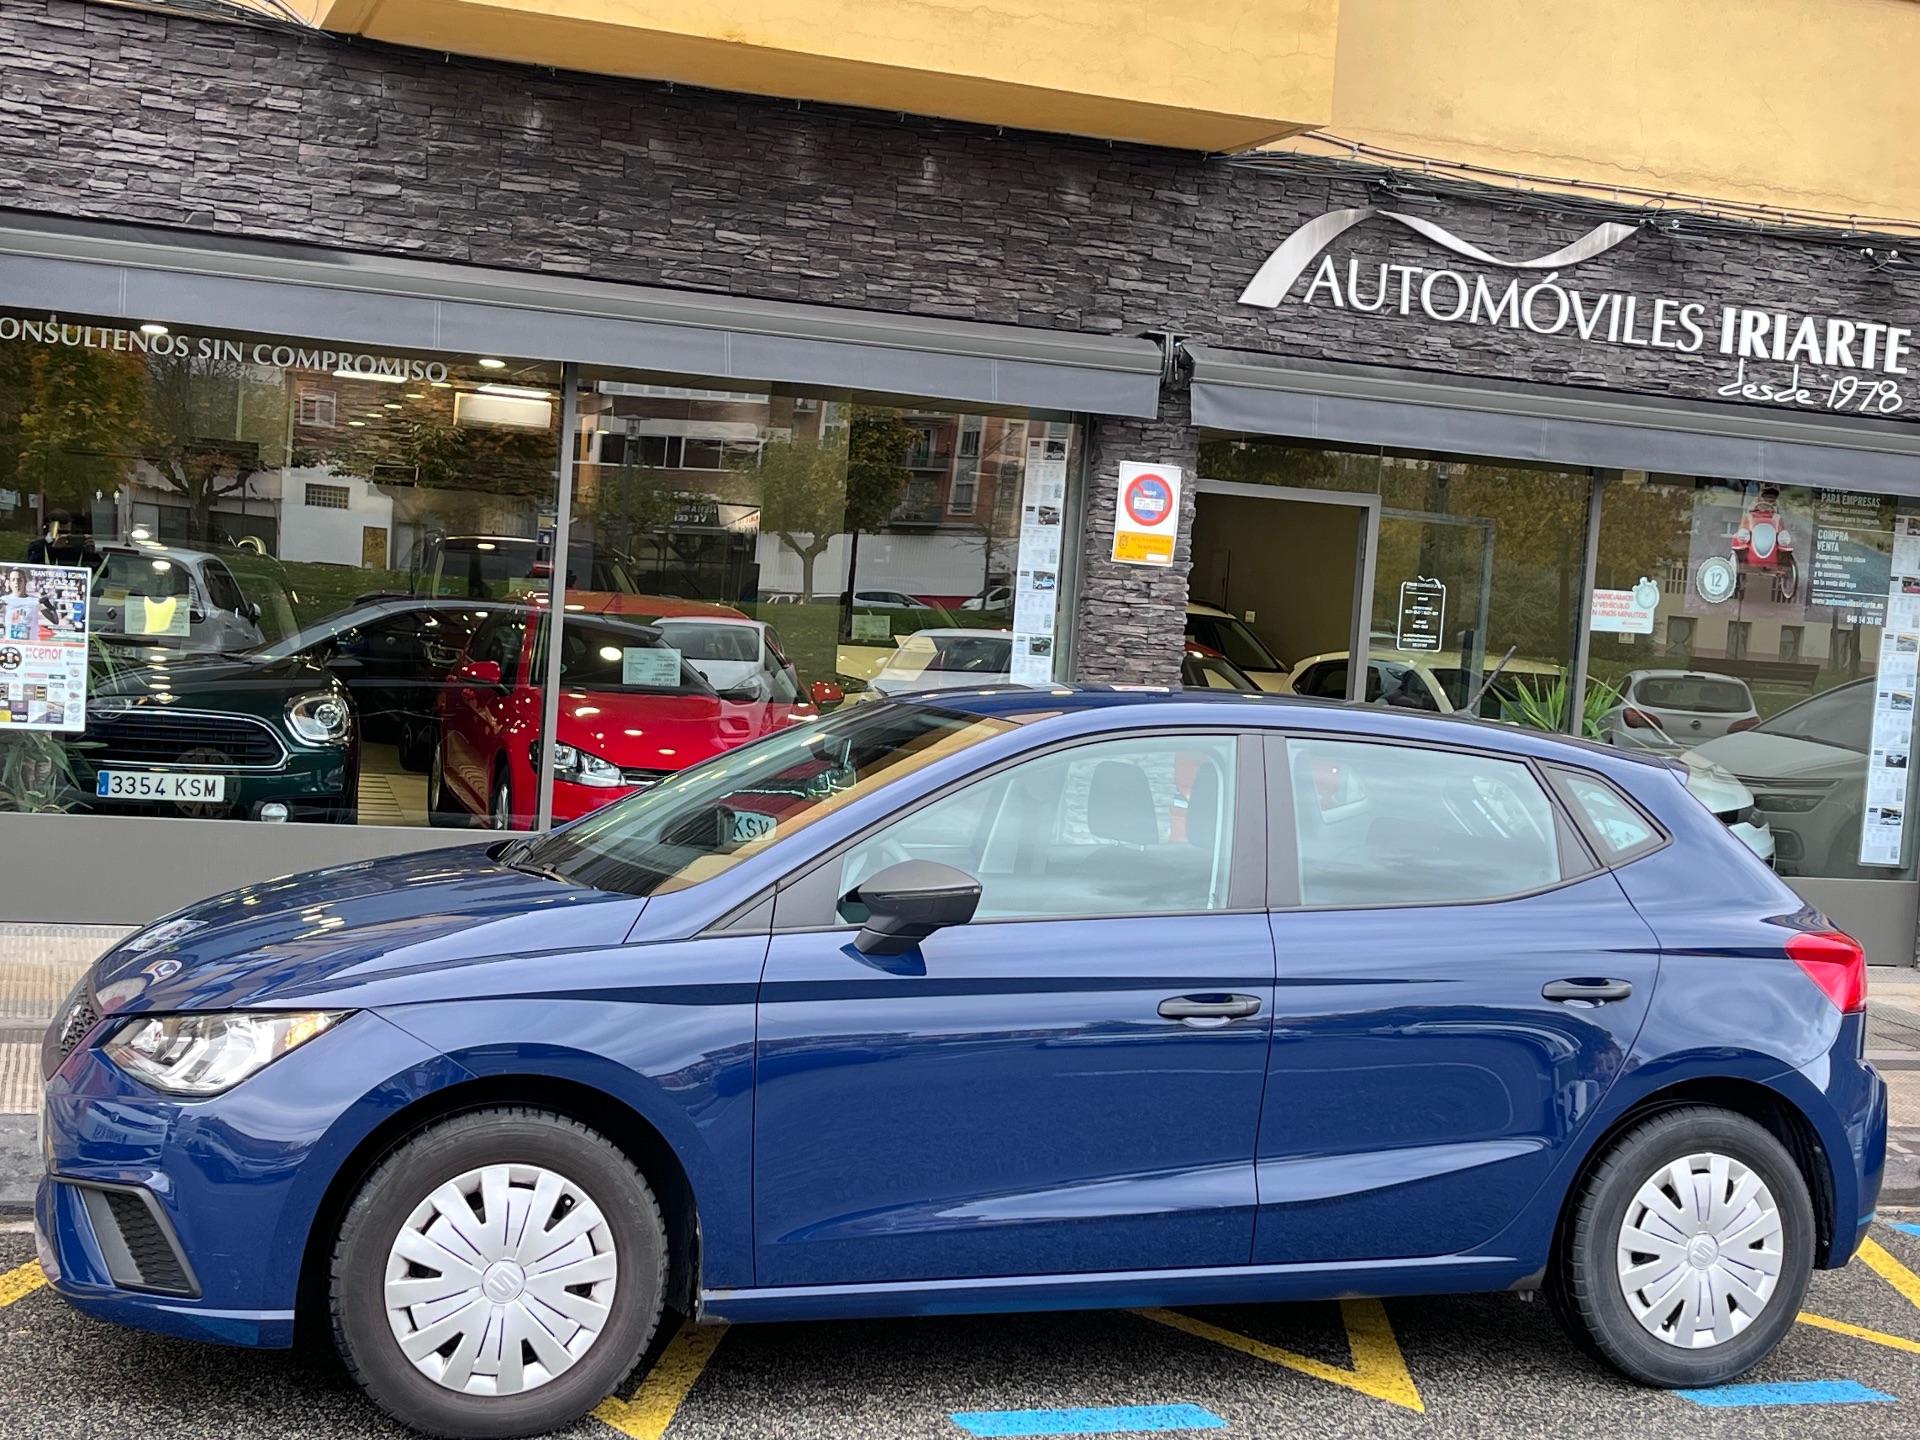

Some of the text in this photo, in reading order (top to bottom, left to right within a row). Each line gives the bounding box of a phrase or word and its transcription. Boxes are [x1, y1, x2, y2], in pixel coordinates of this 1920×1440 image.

[1303, 254, 1911, 374] AUTOMÓVILES IRIARTE
[199, 338, 243, 362] SIN
[253, 344, 447, 382] COMPROMISO
[1718, 358, 1902, 413] desde 1978
[1842, 495, 1880, 508] EMPRESAS
[1818, 529, 1848, 541] COMPRA
[1816, 541, 1839, 552] VENTA
[1711, 572, 1722, 587] 12
[111, 776, 216, 797] 3354 KSM
